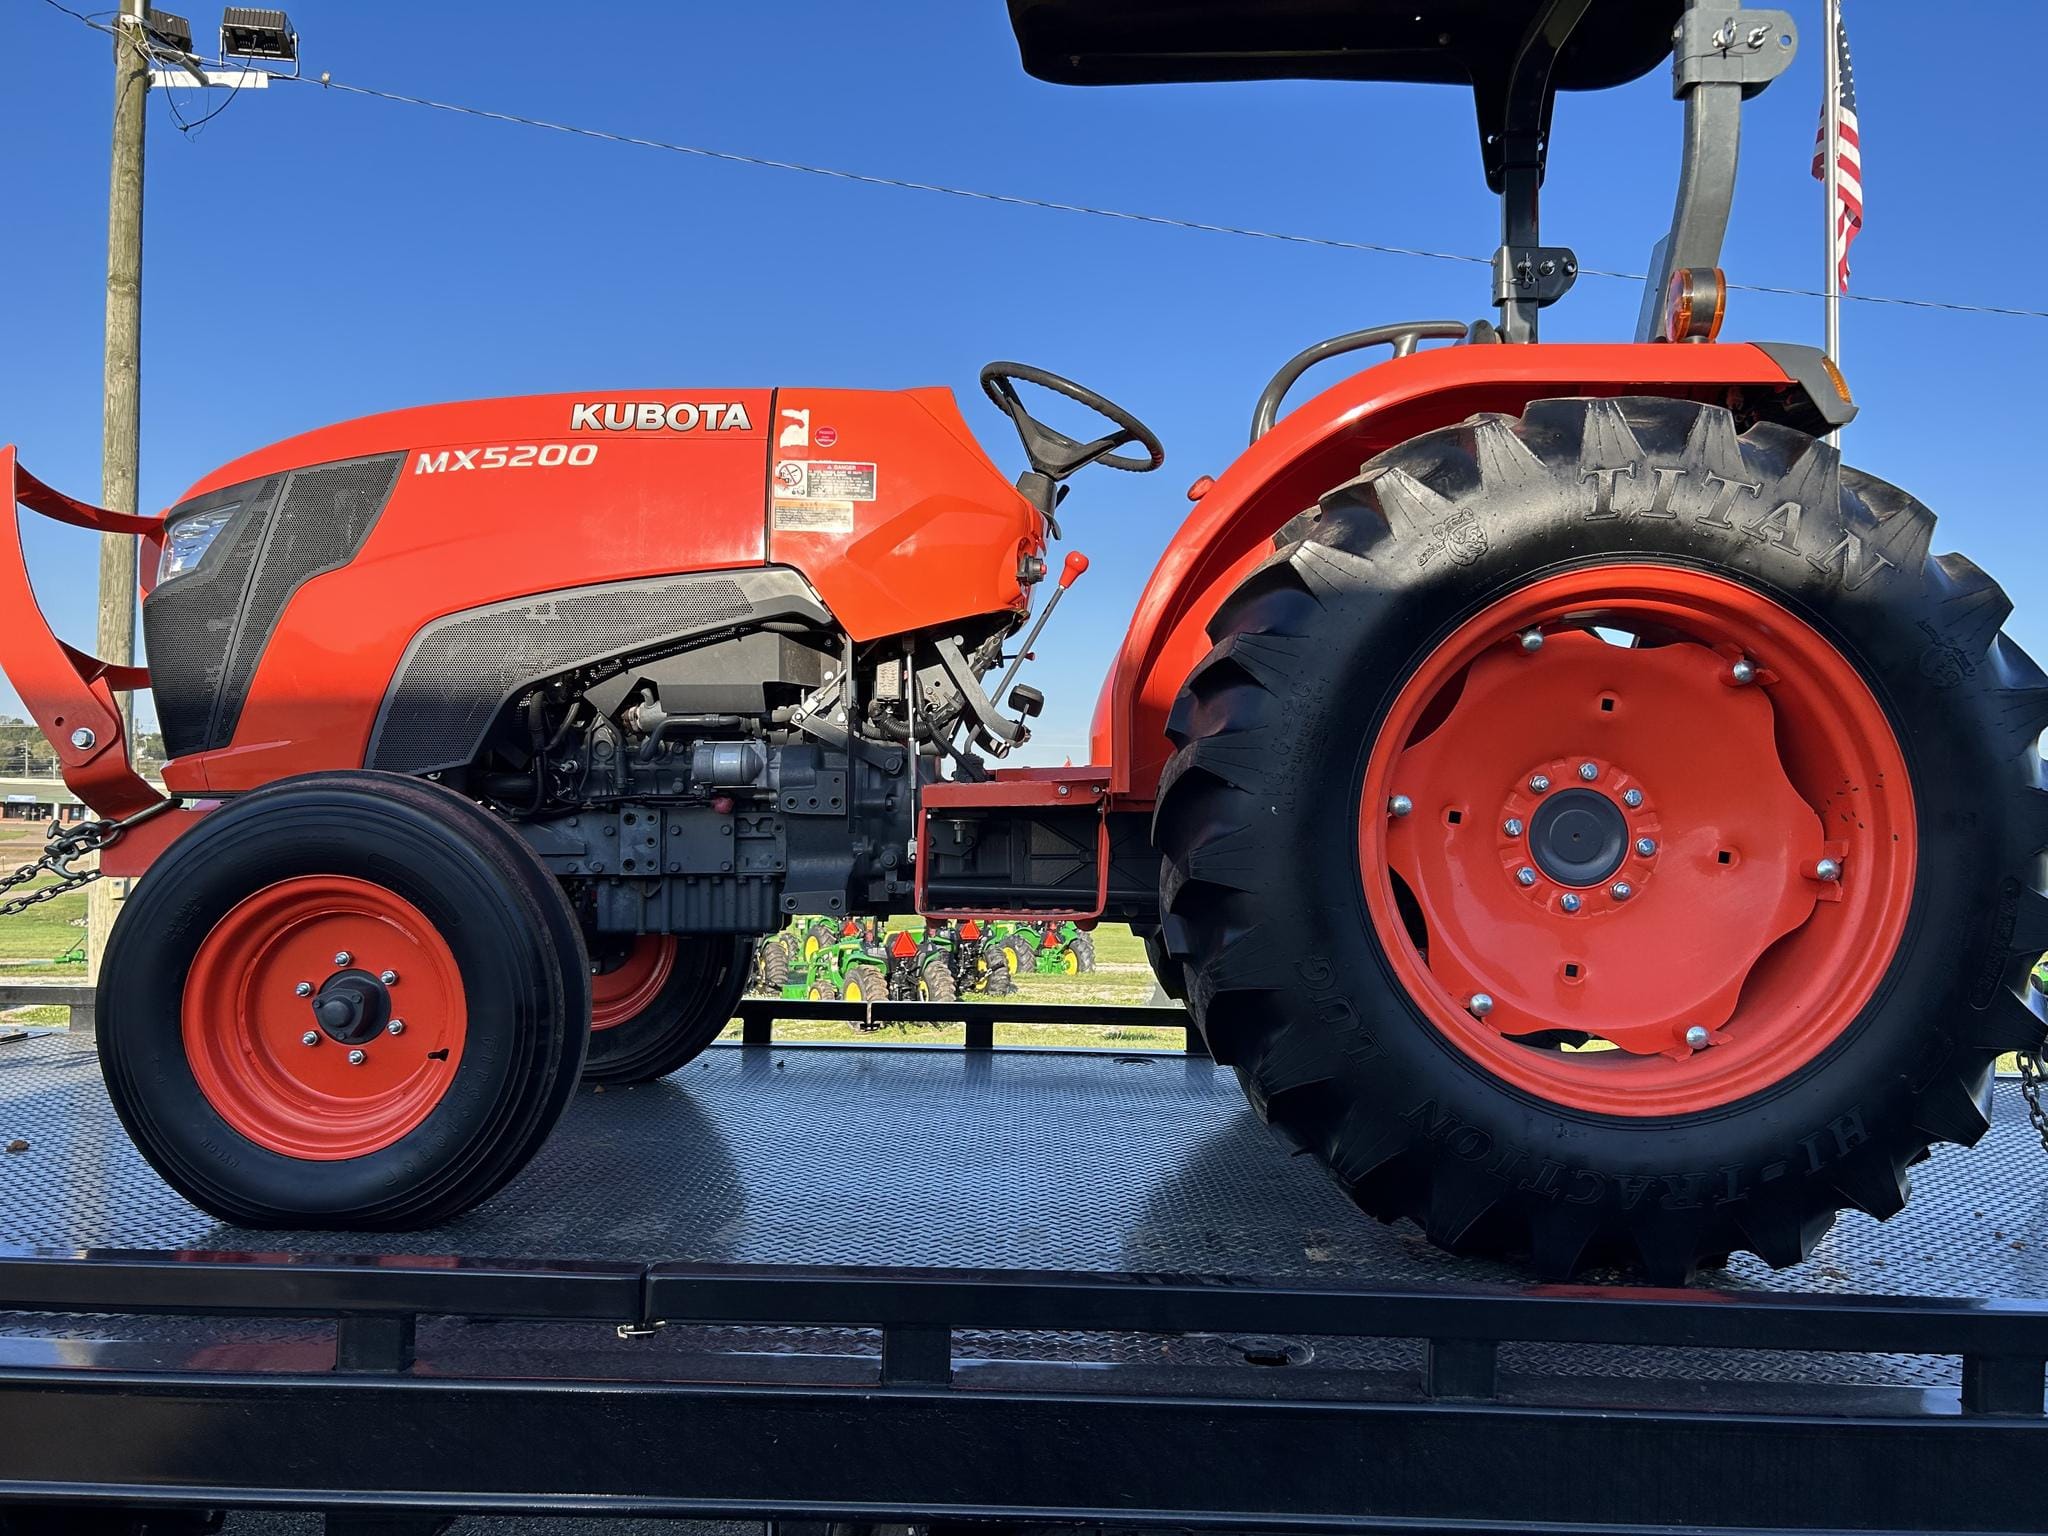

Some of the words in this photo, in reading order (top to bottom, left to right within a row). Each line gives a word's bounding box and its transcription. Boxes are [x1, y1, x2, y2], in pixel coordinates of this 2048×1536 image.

[570, 402, 752, 432] KUBOTA
[415, 444, 599, 475] MX5200
[1577, 459, 1896, 592] TITAN
[1297, 955, 1389, 1072] LUG
